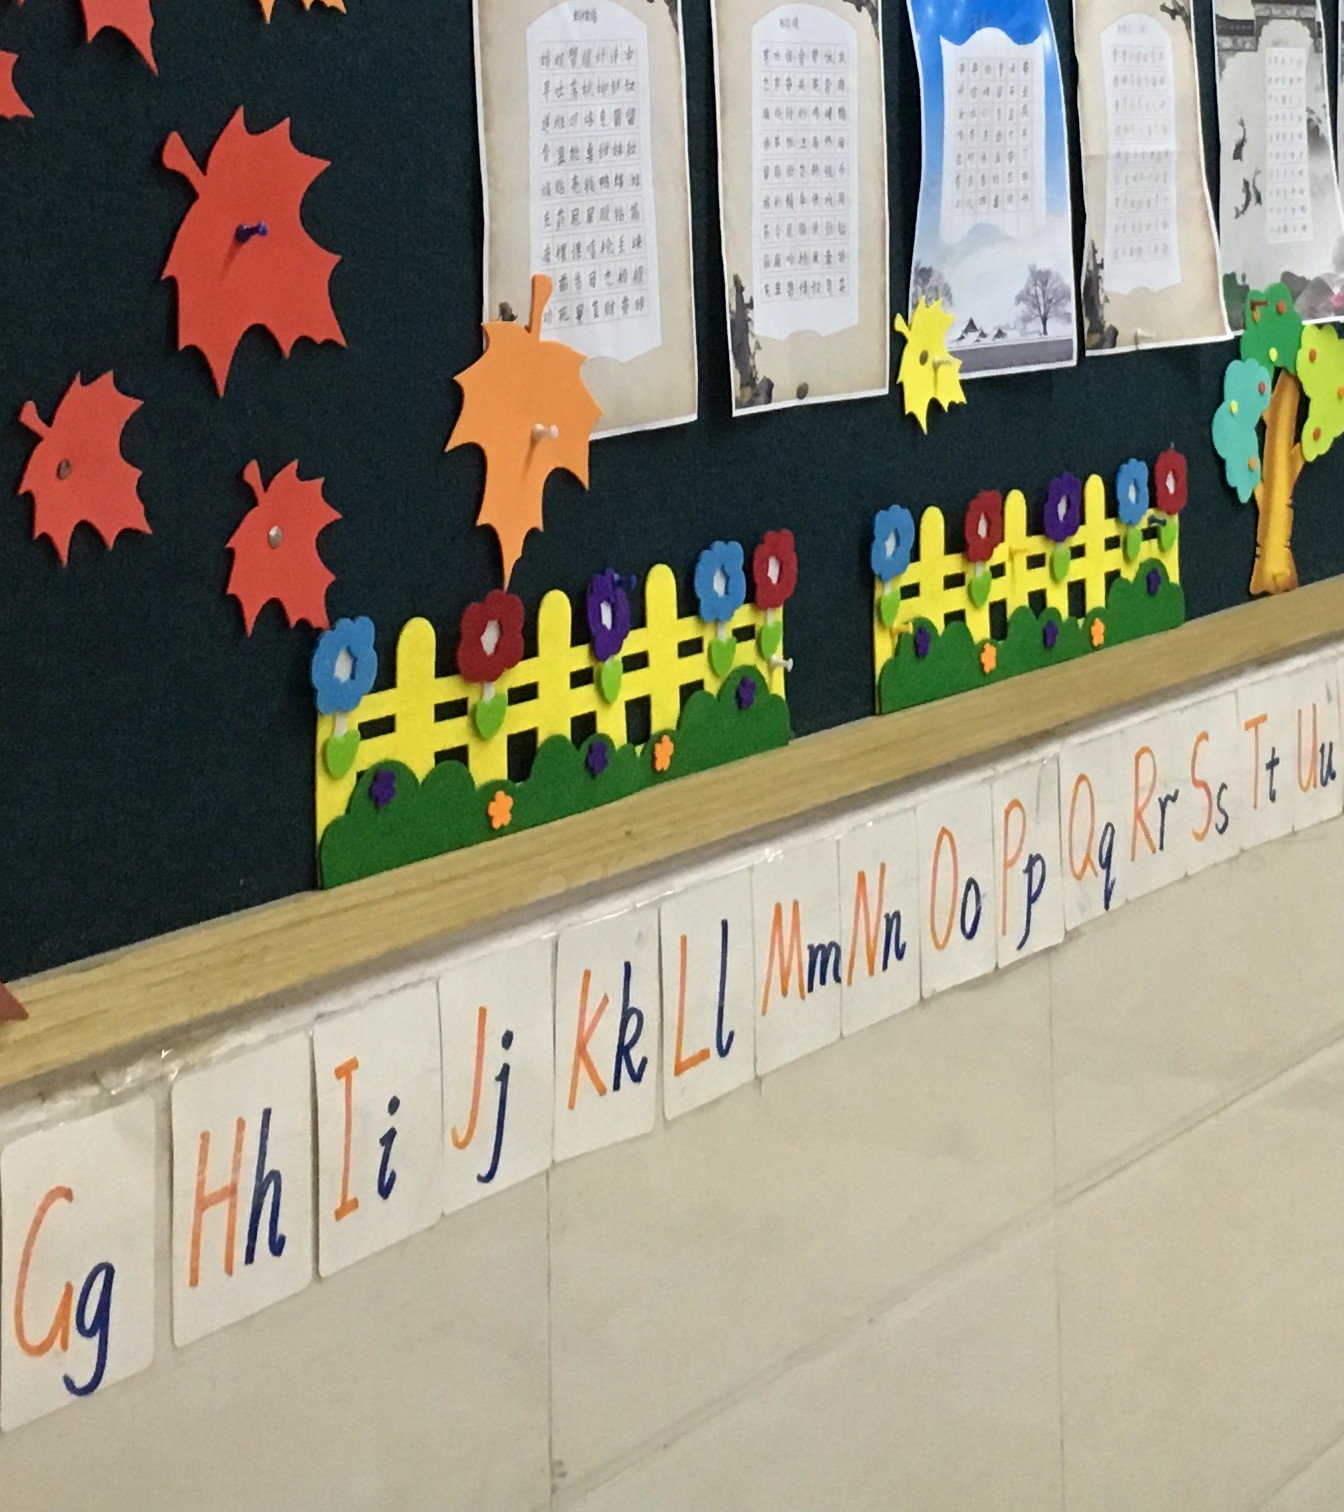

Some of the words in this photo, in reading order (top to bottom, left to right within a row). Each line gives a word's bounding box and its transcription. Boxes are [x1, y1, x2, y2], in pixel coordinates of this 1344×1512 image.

[13, 1185, 117, 1397] Gg
[188, 1107, 287, 1289] Hh
[334, 1056, 401, 1223] Ii
[451, 1006, 515, 1184] Jj
[567, 961, 649, 1111] Kk
[672, 918, 735, 1077] Ll
[761, 899, 842, 1015] Mm
[846, 862, 907, 987] Nn
[929, 826, 982, 951] Oo
[1000, 797, 1047, 951] Pp
[1067, 773, 1117, 912] Qq
[1130, 745, 1179, 862] Rr
[1190, 730, 1230, 842] Ss
[1243, 712, 1281, 811] Tt
[1296, 703, 1337, 793] Uu
